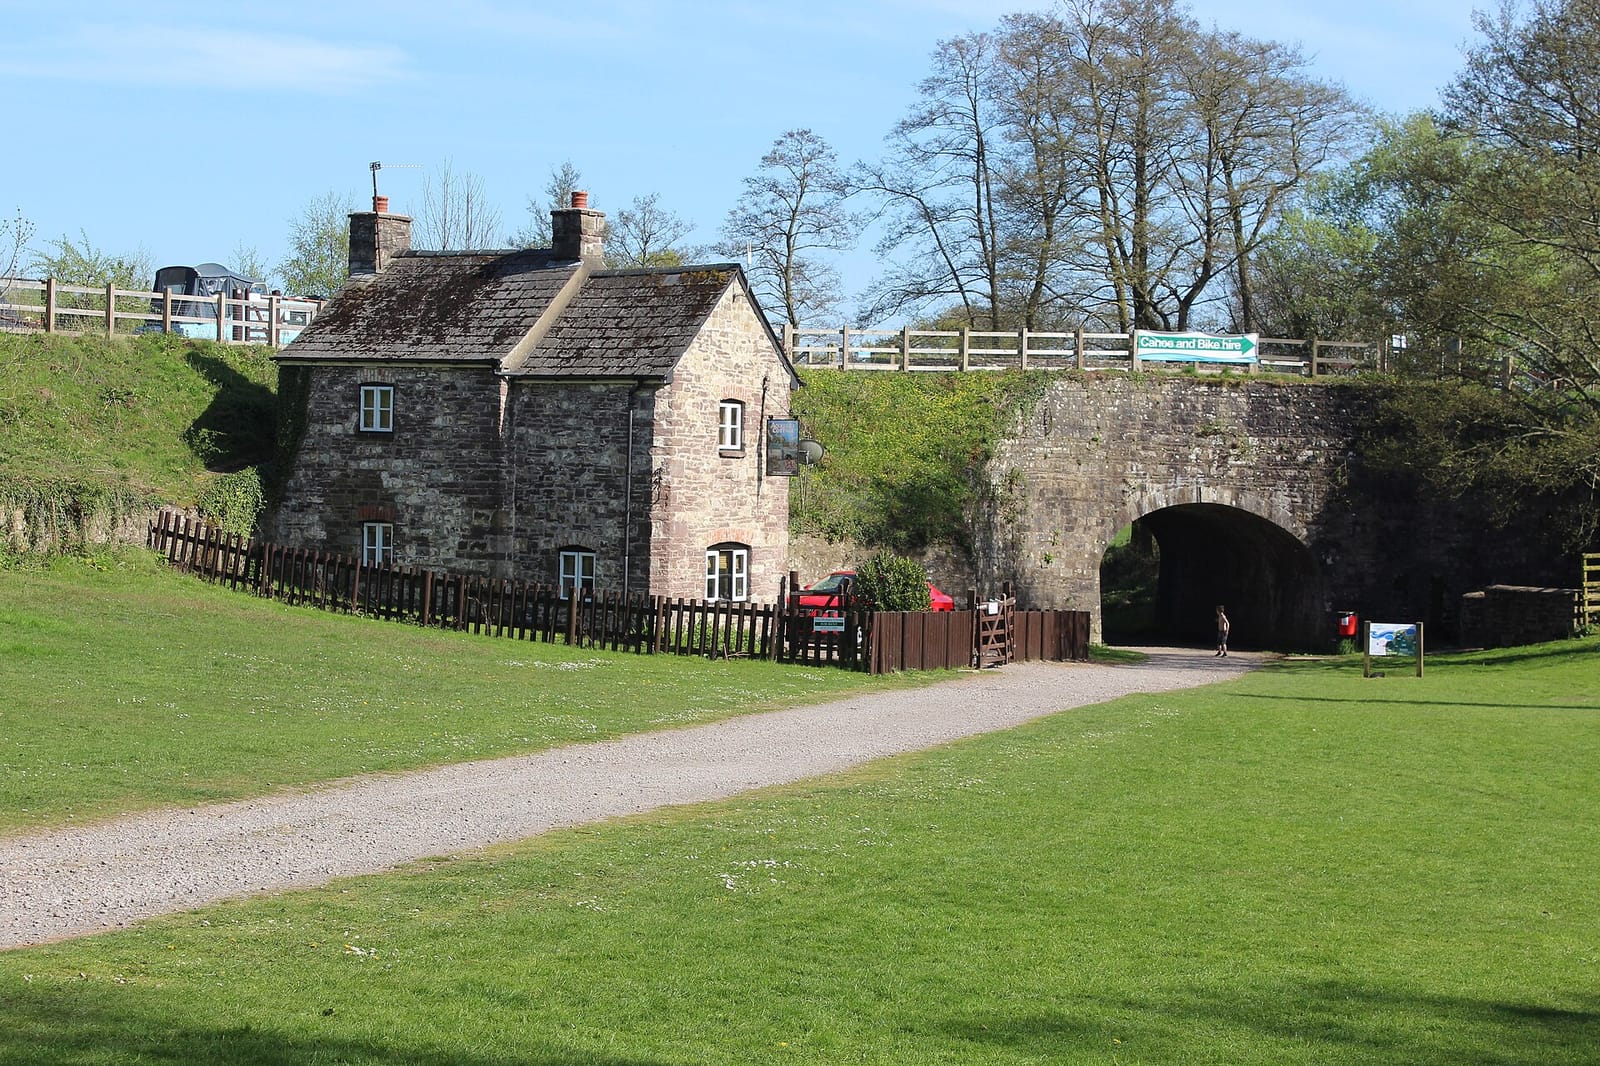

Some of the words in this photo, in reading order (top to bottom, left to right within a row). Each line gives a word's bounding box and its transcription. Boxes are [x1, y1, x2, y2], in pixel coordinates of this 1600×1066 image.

[1140, 337, 1174, 348] Canoe
[1176, 338, 1196, 349] and
[1197, 339, 1220, 349] Bike
[1222, 340, 1242, 350] hire
